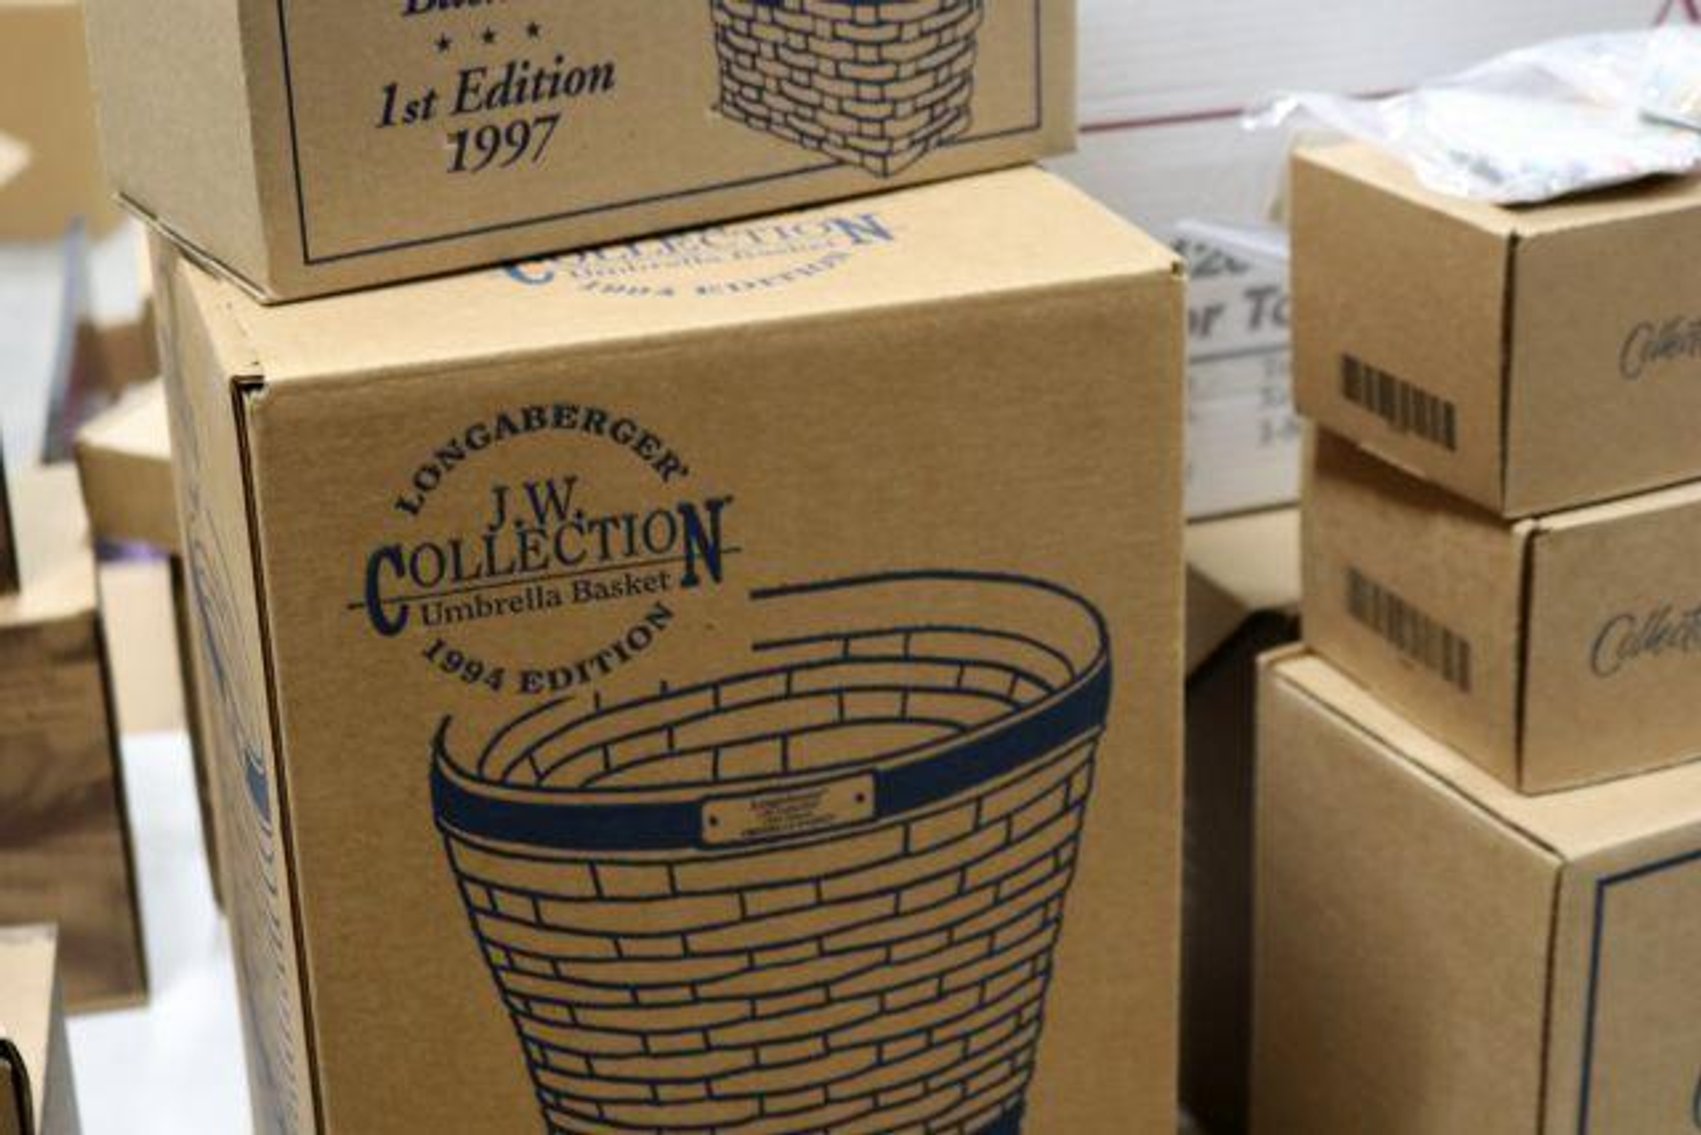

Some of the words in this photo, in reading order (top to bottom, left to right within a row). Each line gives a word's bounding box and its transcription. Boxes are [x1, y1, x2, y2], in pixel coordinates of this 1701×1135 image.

[375, 81, 438, 129] 1st
[450, 53, 616, 117] Edition
[446, 111, 562, 174] 1997
[488, 473, 585, 533] J.W.
[365, 495, 734, 638] COLLECTION
[421, 583, 562, 627] Umbrella
[571, 570, 672, 603] Basket
[422, 637, 504, 693] 1994
[519, 600, 675, 695] EDITION
